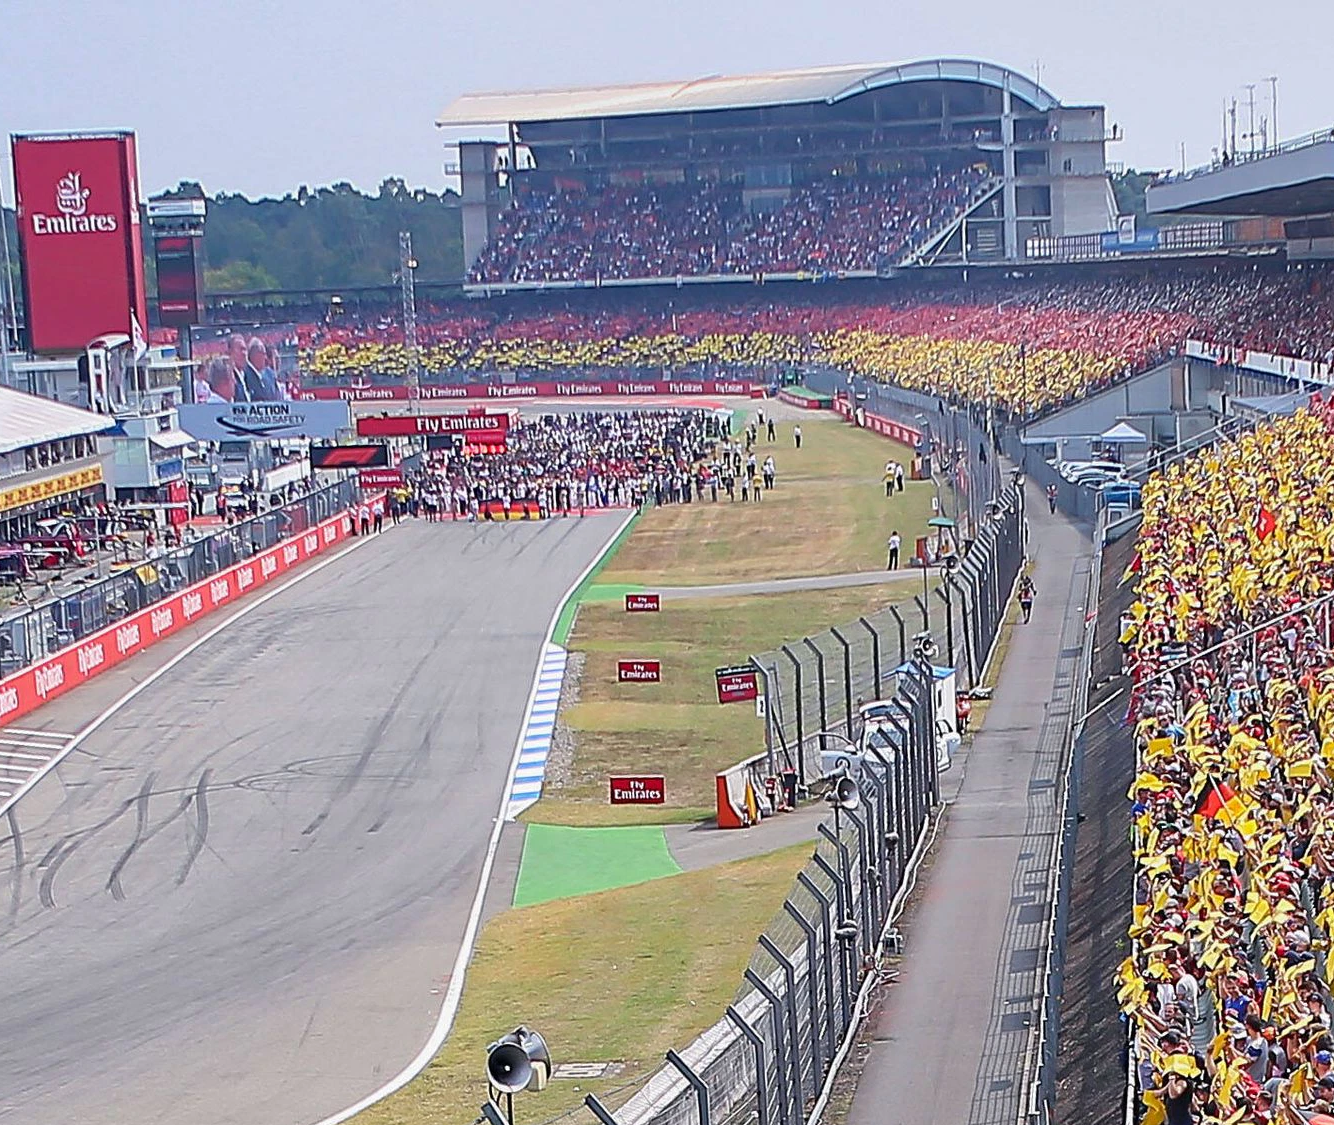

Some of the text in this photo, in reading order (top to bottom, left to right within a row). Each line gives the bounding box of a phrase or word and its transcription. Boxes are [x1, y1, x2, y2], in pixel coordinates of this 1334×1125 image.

[33, 213, 117, 235] Emirates
[249, 404, 290, 415] ACTION
[417, 415, 500, 433] Fly Emirates
[633, 664, 644, 672] Fly
[621, 670, 657, 679] Emirates
[630, 781, 644, 789] Fly
[614, 788, 661, 799] Emirates
